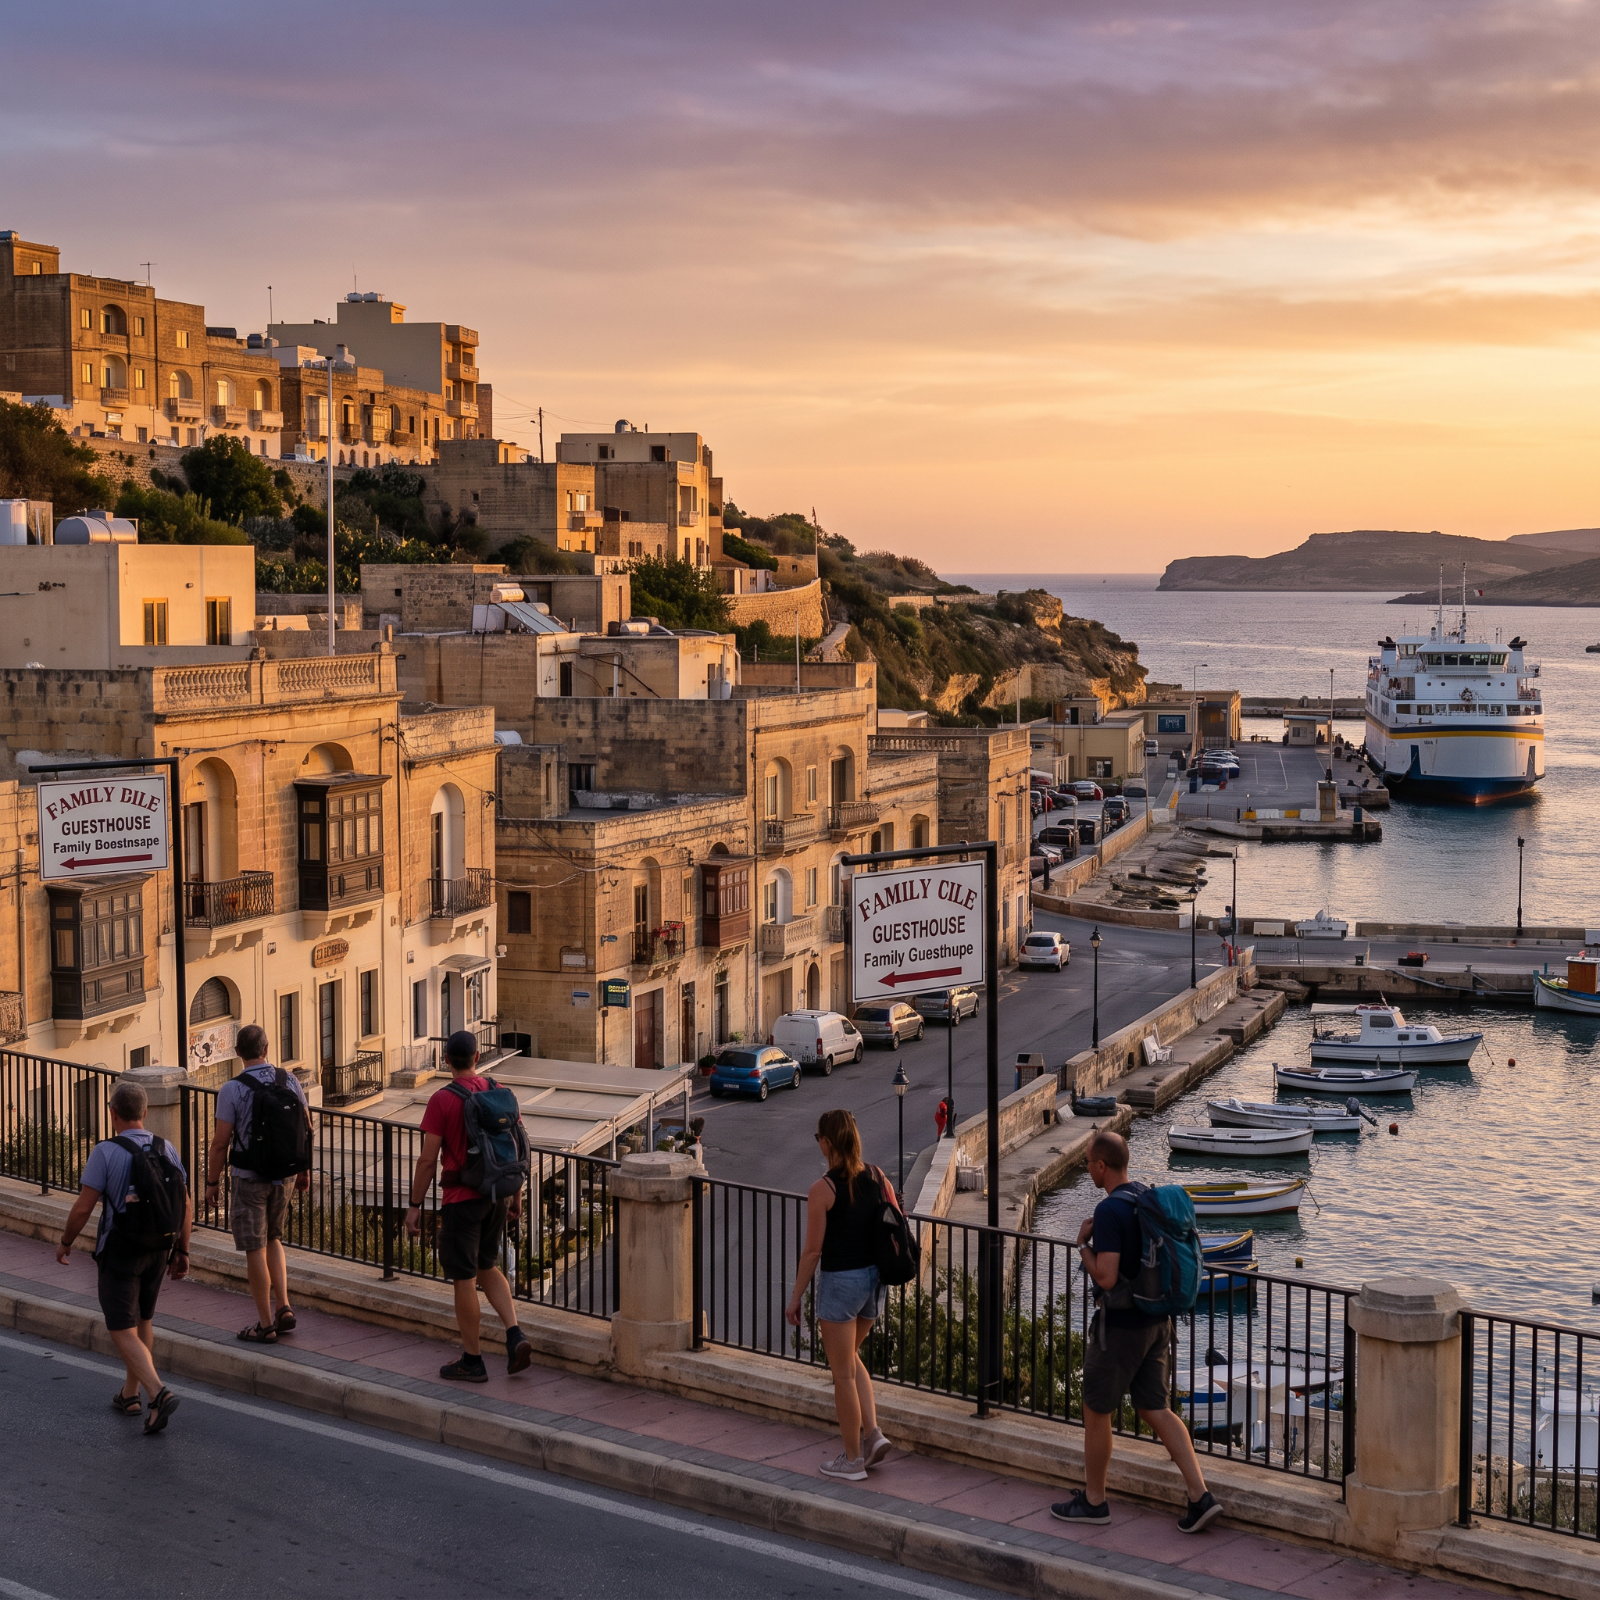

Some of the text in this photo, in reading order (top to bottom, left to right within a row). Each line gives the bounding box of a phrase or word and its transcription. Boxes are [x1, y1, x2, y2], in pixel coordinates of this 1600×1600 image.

[45, 786, 115, 821] FAMILY
[61, 815, 151, 836] GUESTHOUSE
[53, 841, 91, 855] Family
[858, 878, 978, 923] FAMILY CILE
[872, 915, 966, 944] GUESTHOUSE
[864, 943, 974, 968] Family Guesthupe
